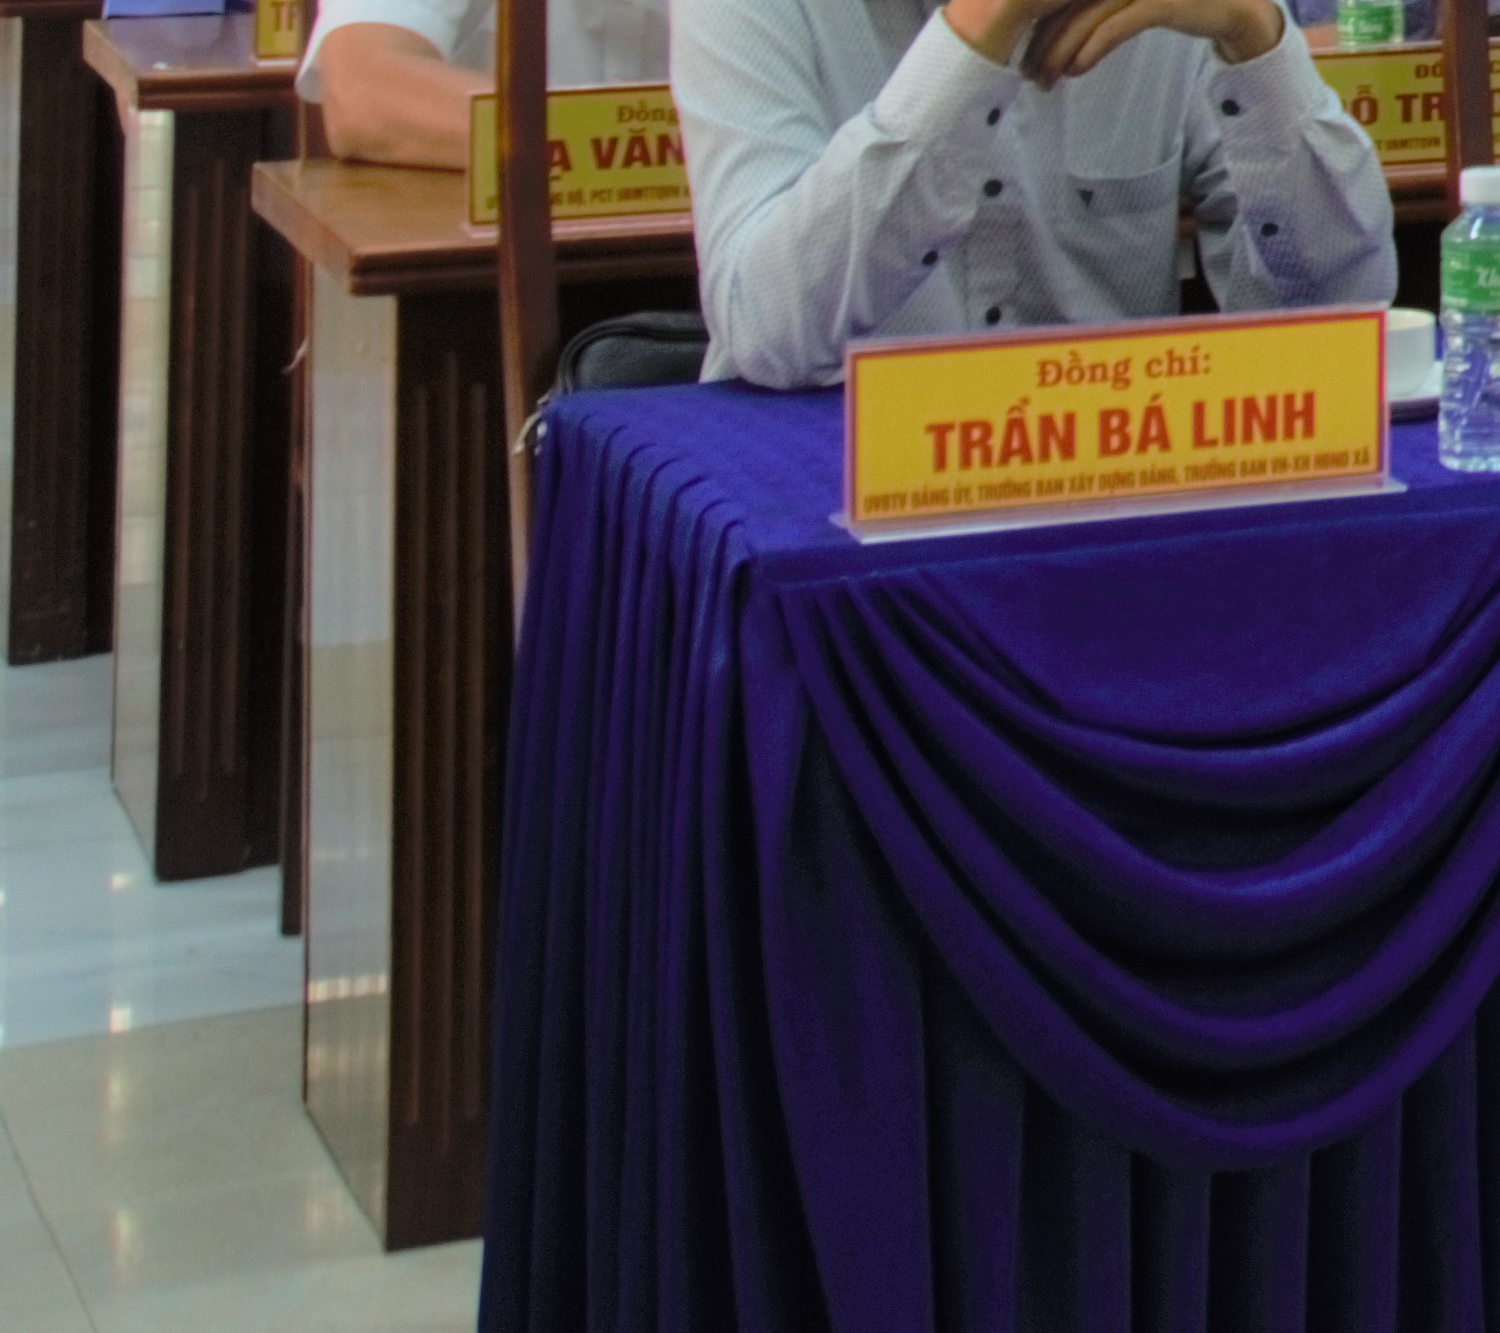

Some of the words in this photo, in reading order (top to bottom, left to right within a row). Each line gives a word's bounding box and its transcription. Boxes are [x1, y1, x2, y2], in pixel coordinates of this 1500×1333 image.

[592, 128, 685, 169] VĂN
[1037, 350, 1131, 391] Đồng
[1145, 345, 1211, 379] chí:
[1097, 393, 1171, 459] BÁ
[1191, 391, 1315, 451] LINH
